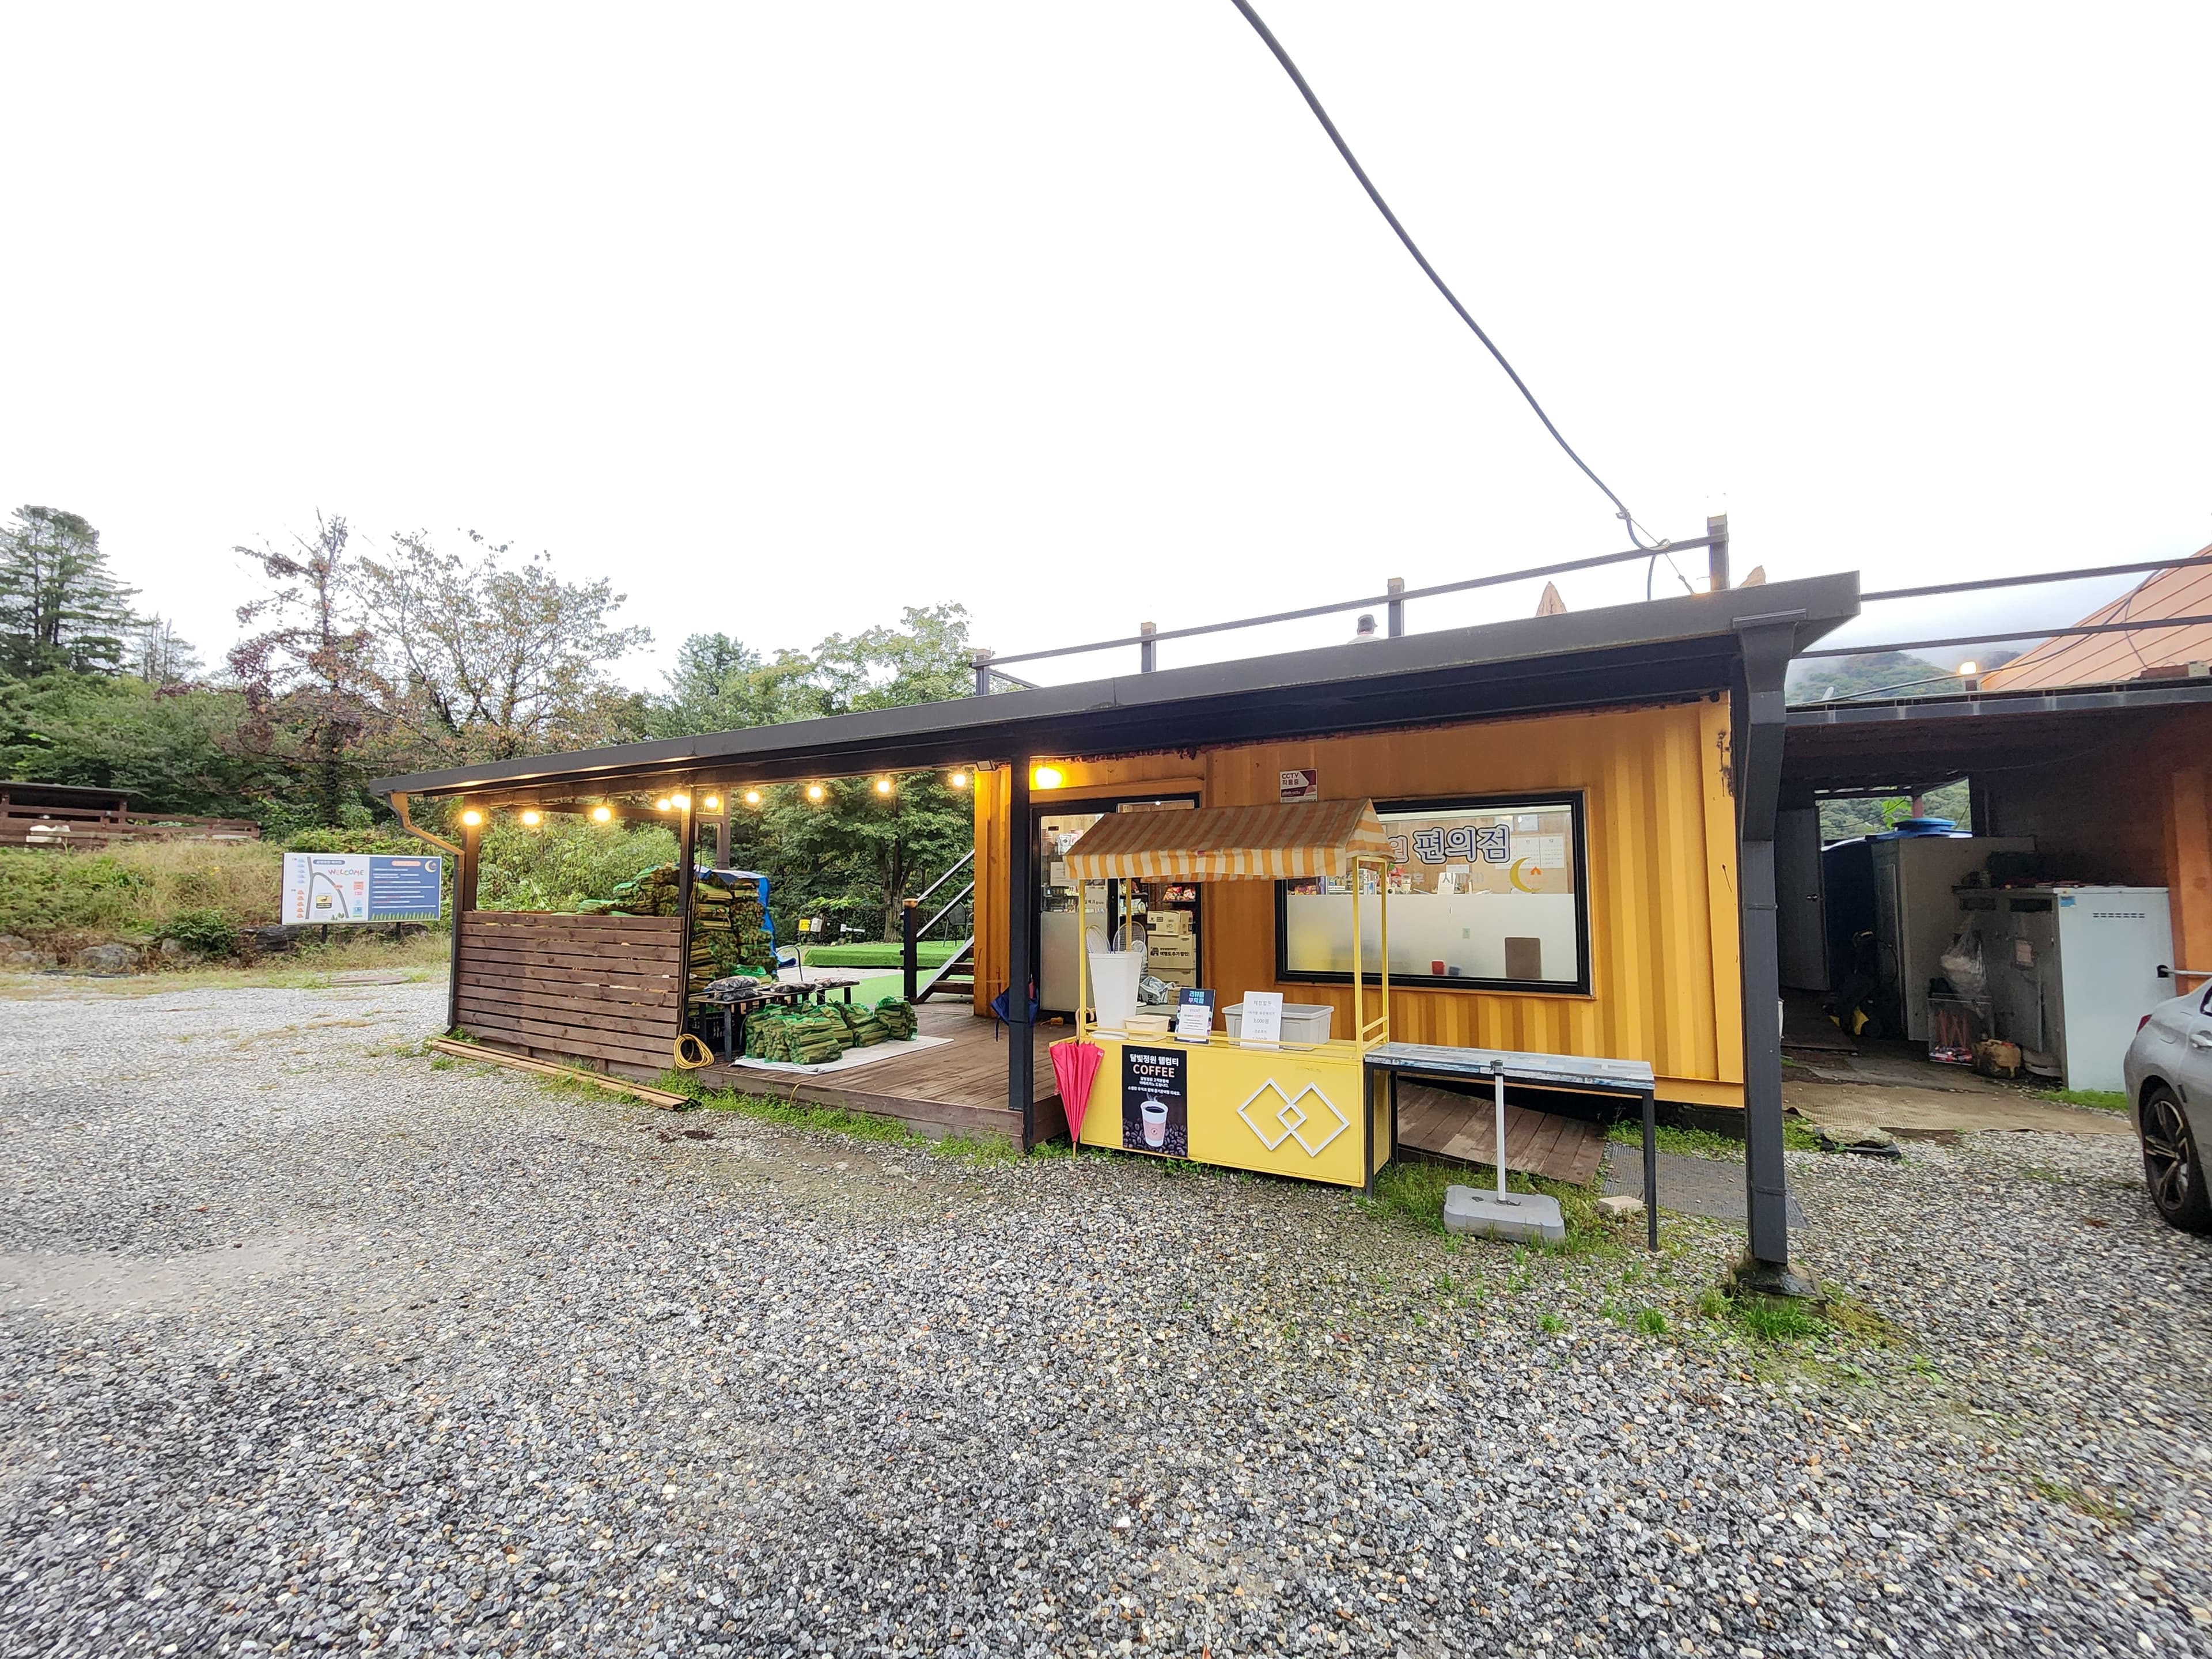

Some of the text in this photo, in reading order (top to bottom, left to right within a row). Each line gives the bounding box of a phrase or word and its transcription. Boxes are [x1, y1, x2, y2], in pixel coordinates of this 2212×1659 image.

[1413, 825, 1510, 863] 편의점
[1130, 1054, 1179, 1067] 달빛정원 웰컴티
[1132, 1064, 1175, 1078] COFFEE
